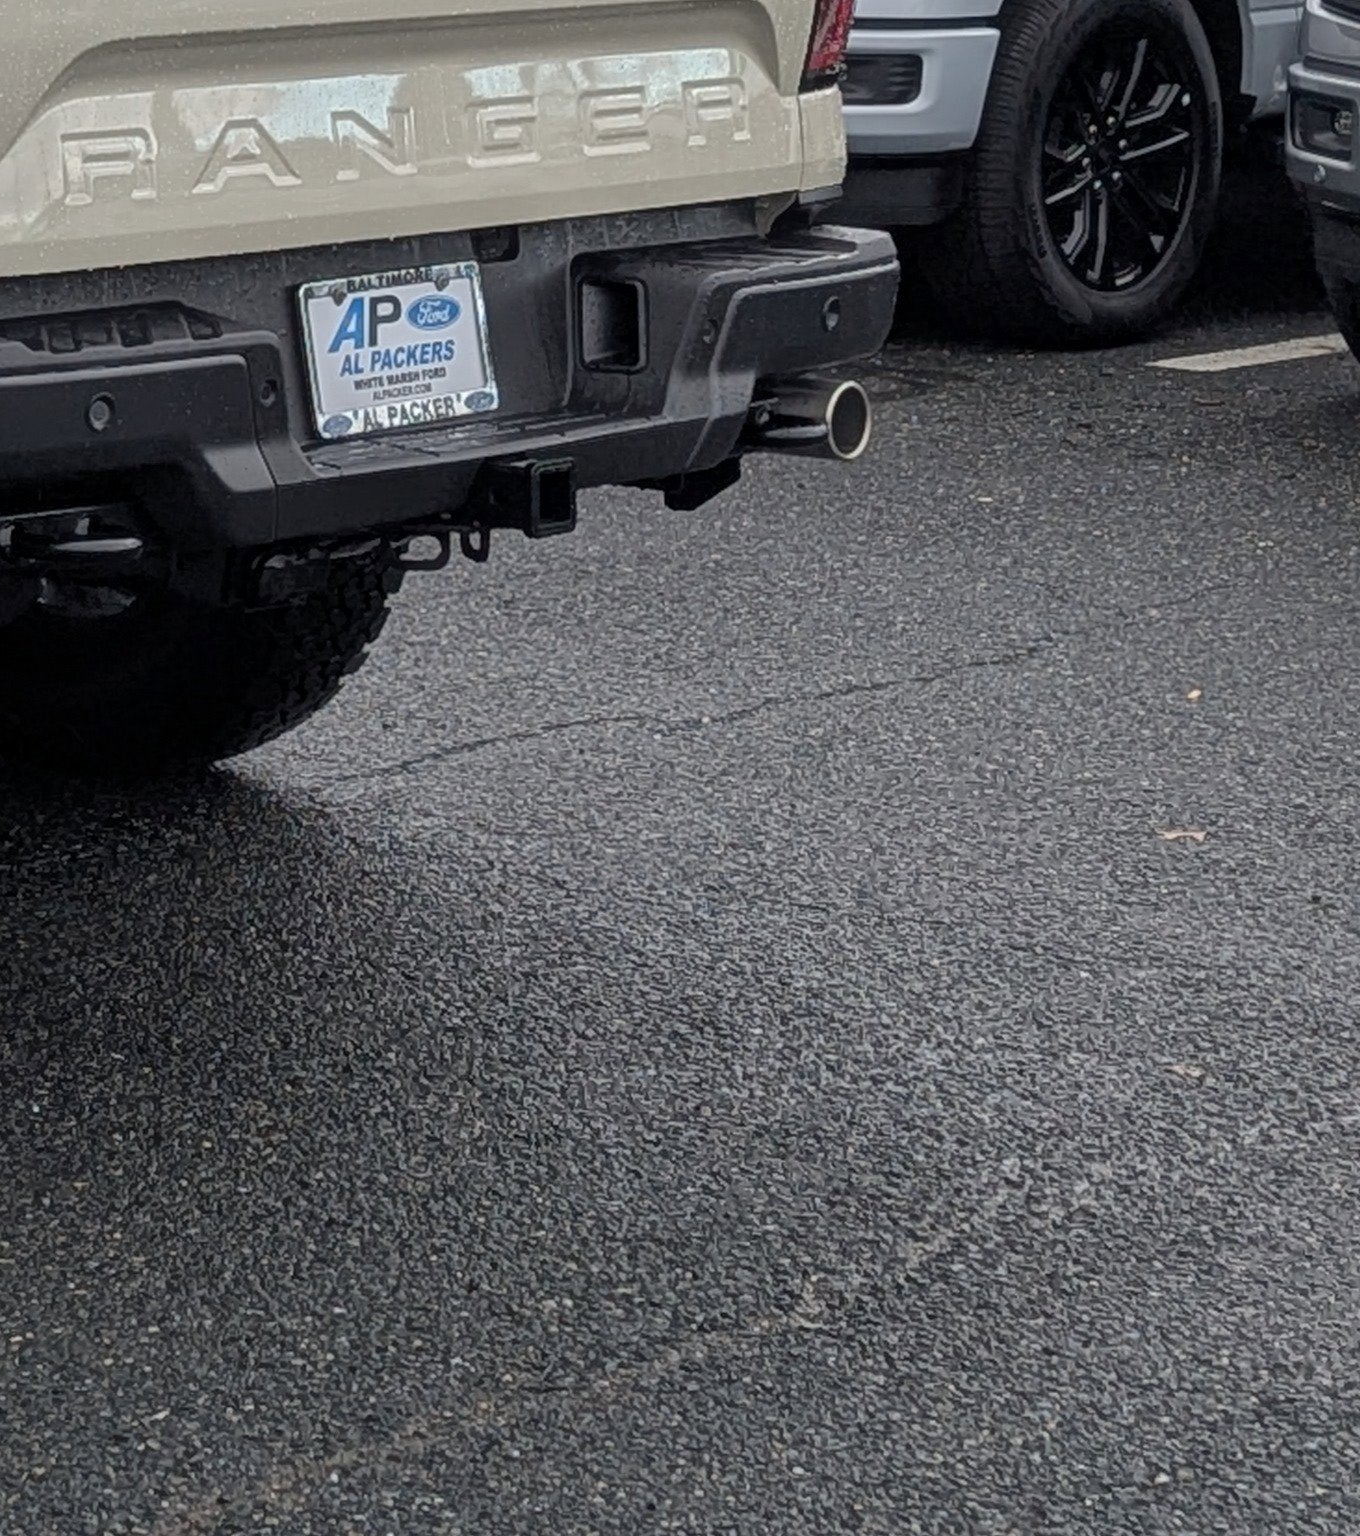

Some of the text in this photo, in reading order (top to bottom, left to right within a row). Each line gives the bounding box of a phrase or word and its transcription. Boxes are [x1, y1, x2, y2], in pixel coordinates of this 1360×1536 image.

[59, 77, 752, 205] RANGER
[346, 266, 434, 293] BALTIMORE
[327, 294, 402, 354] AP
[340, 339, 456, 377] AL PACKERS
[353, 366, 447, 391] WHITE MARSH FORD
